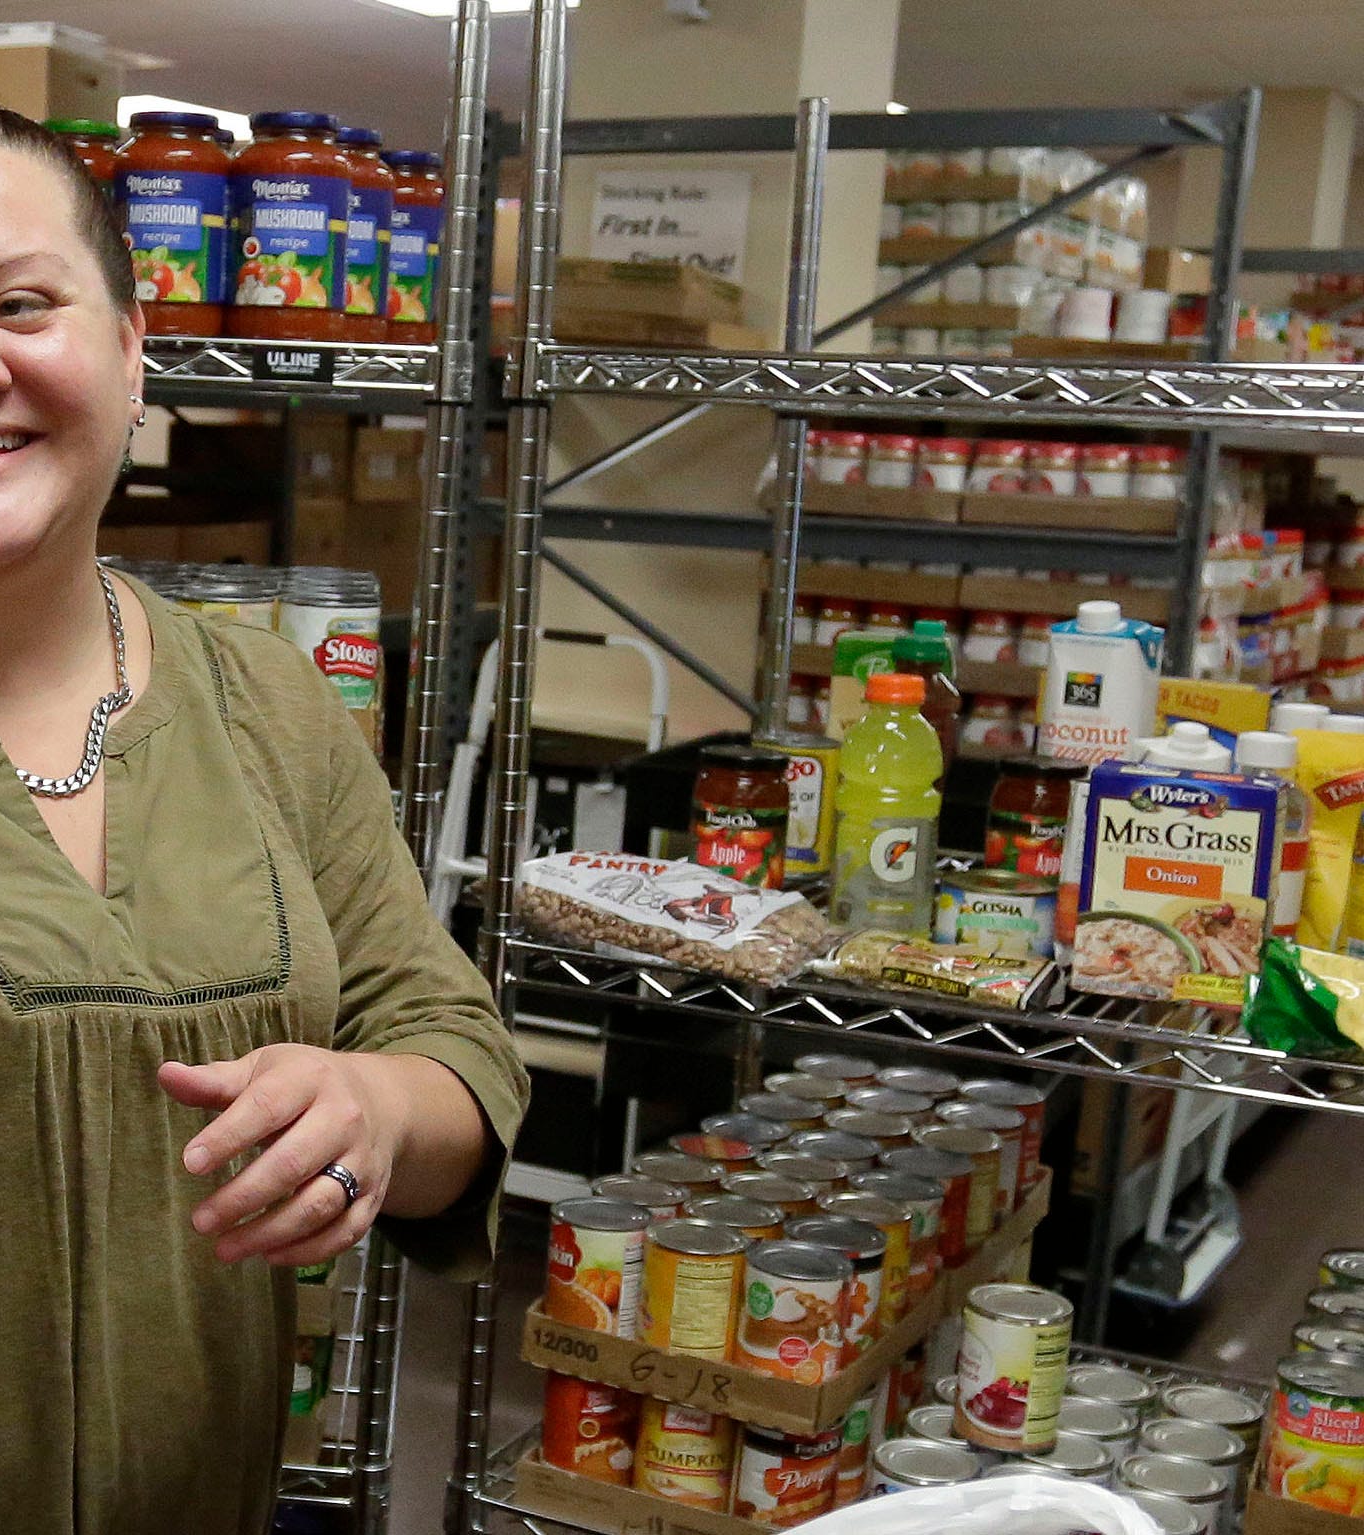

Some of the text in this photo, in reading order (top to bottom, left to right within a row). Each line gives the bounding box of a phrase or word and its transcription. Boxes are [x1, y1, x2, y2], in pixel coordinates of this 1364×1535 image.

[129, 203, 198, 226] MUSHROOM
[255, 208, 326, 231] MUSHROOM
[268, 237, 310, 250] recipe
[267, 351, 321, 369] ULINE
[1071, 684, 1097, 703] 365
[1149, 784, 1210, 805] Wyler's
[1165, 821, 1253, 854] Grass
[569, 854, 668, 875] PANTRY
[710, 842, 748, 867] Apple
[870, 828, 918, 883] G
[1146, 866, 1199, 887] Onion
[972, 900, 1023, 918] GEISHA
[534, 1328, 598, 1363] 12/300
[1313, 1412, 1361, 1430] Sliced
